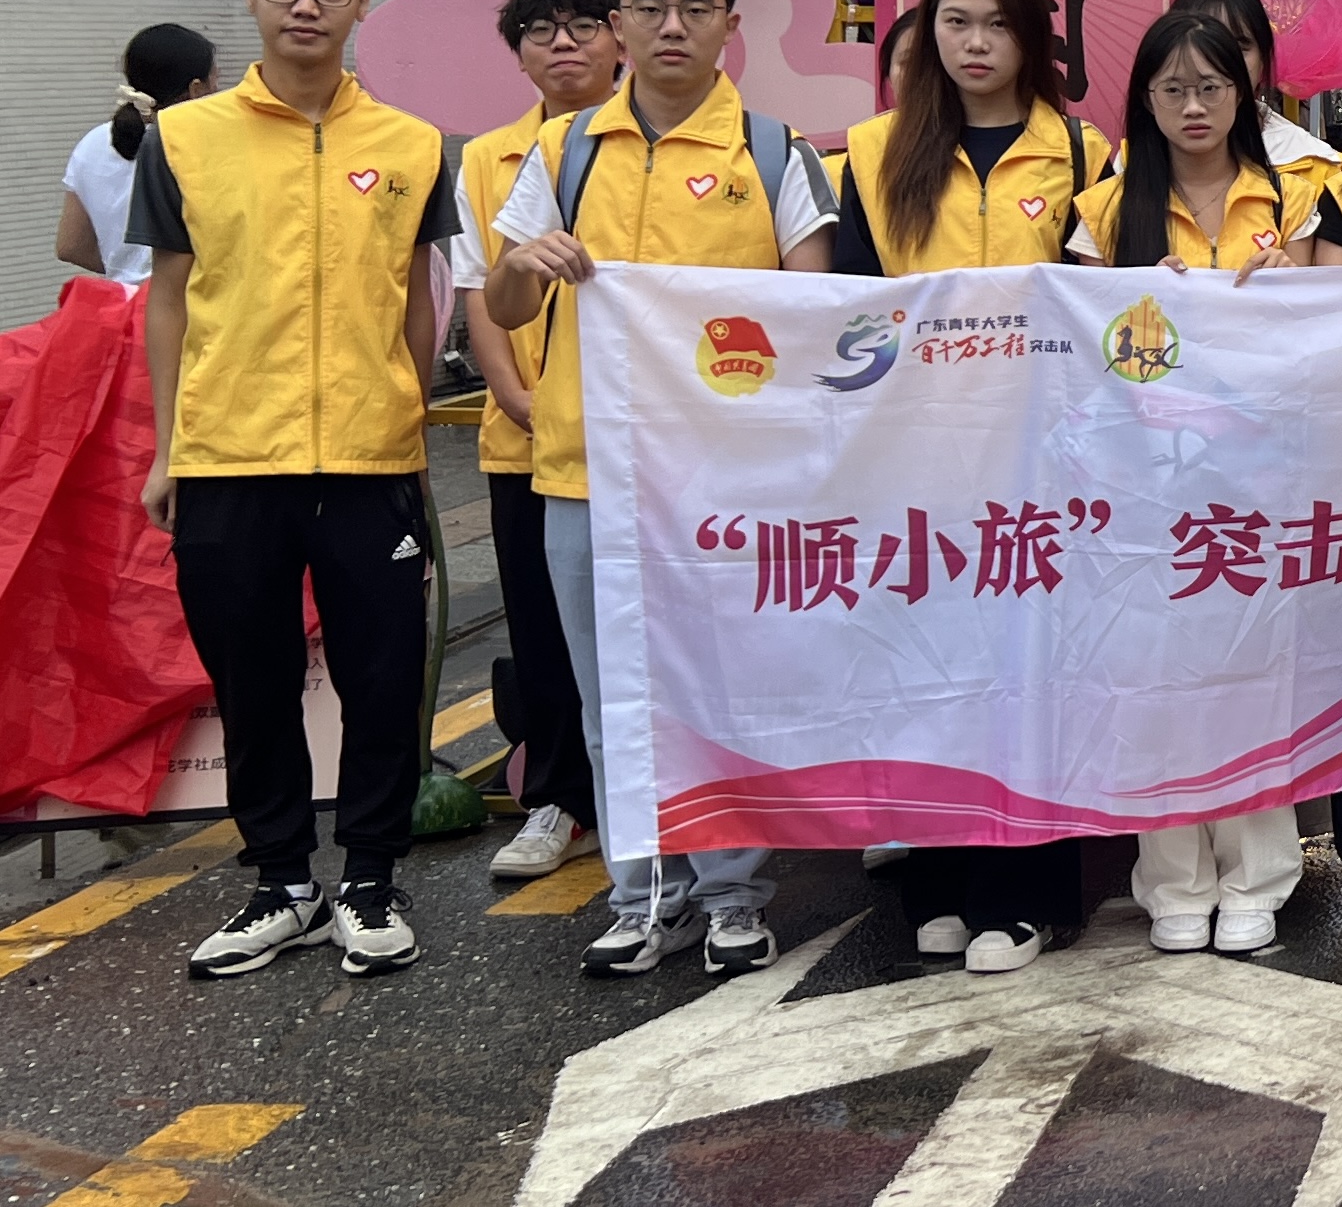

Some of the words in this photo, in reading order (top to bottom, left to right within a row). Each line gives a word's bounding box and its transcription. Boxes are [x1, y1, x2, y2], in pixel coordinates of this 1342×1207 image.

[915, 314, 1029, 335] 广东青年大学生
[695, 496, 1112, 613] “顺小旅”
